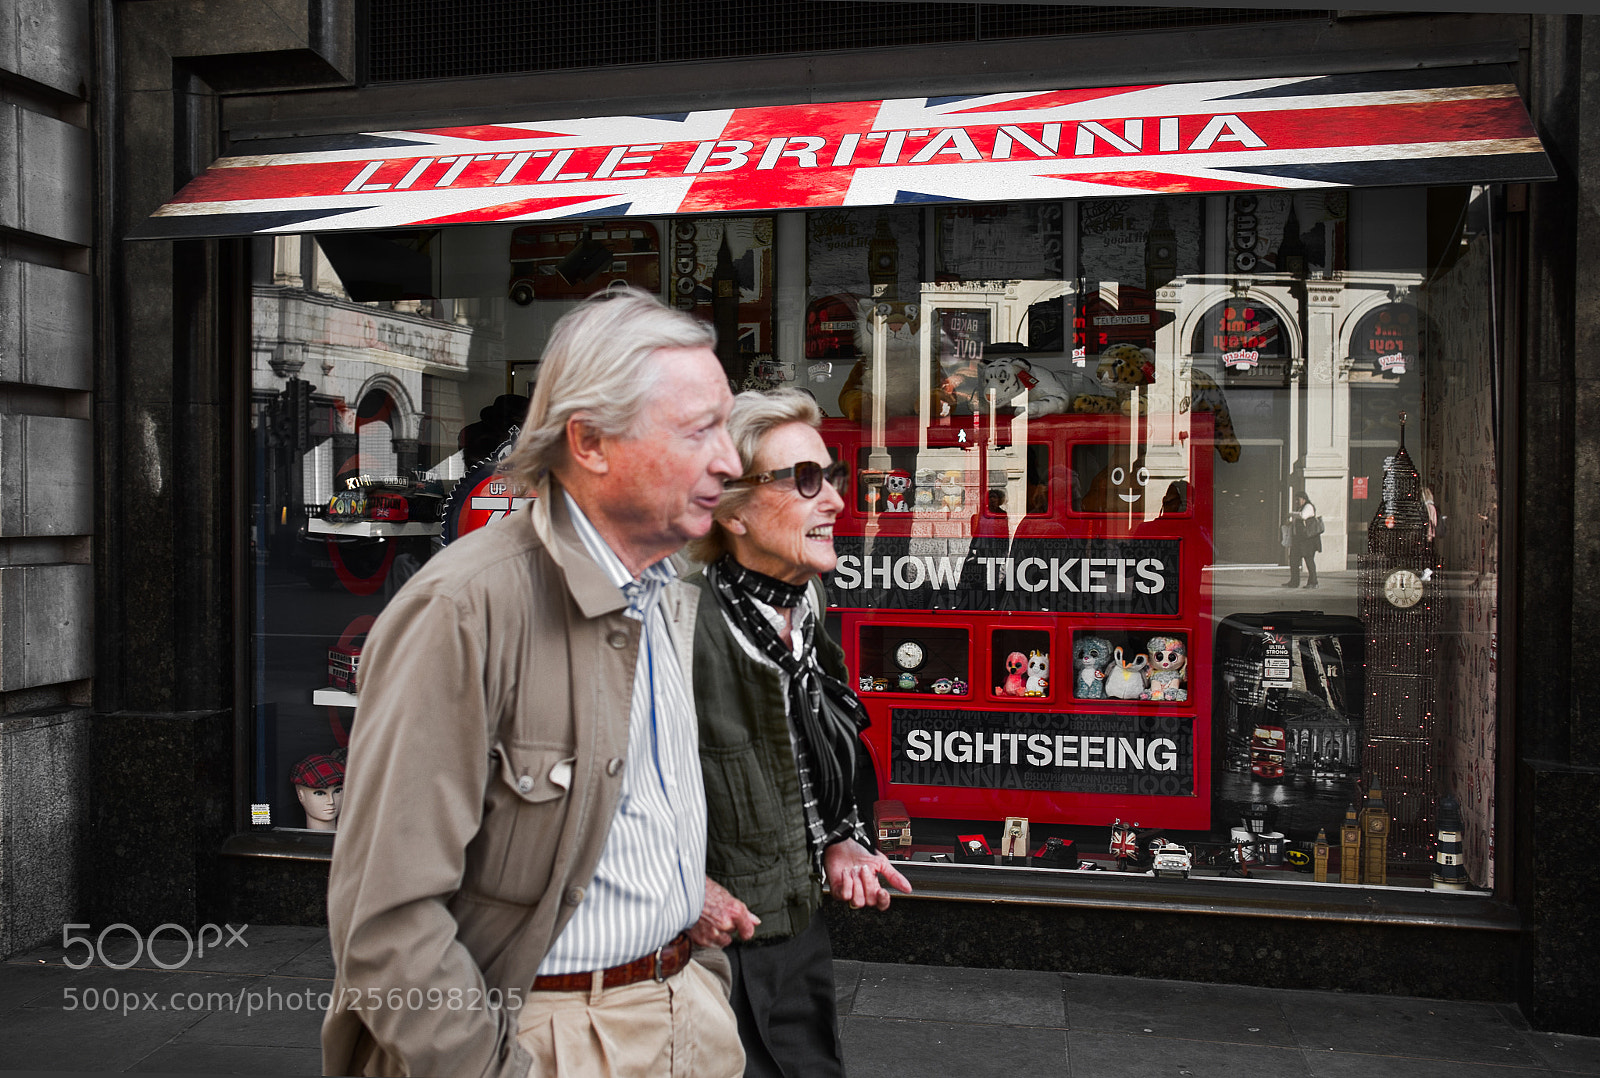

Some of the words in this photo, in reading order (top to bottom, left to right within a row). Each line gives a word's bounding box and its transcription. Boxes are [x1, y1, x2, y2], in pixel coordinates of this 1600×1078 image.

[342, 144, 664, 193] LITTLE
[682, 114, 1268, 175] BRITANNIA
[1096, 315, 1145, 325] TELEPHONE
[490, 483, 507, 495] UP
[834, 554, 967, 591] SHOW
[977, 557, 1166, 595] TICKETS
[906, 729, 1178, 772] SIGHTSEEING
